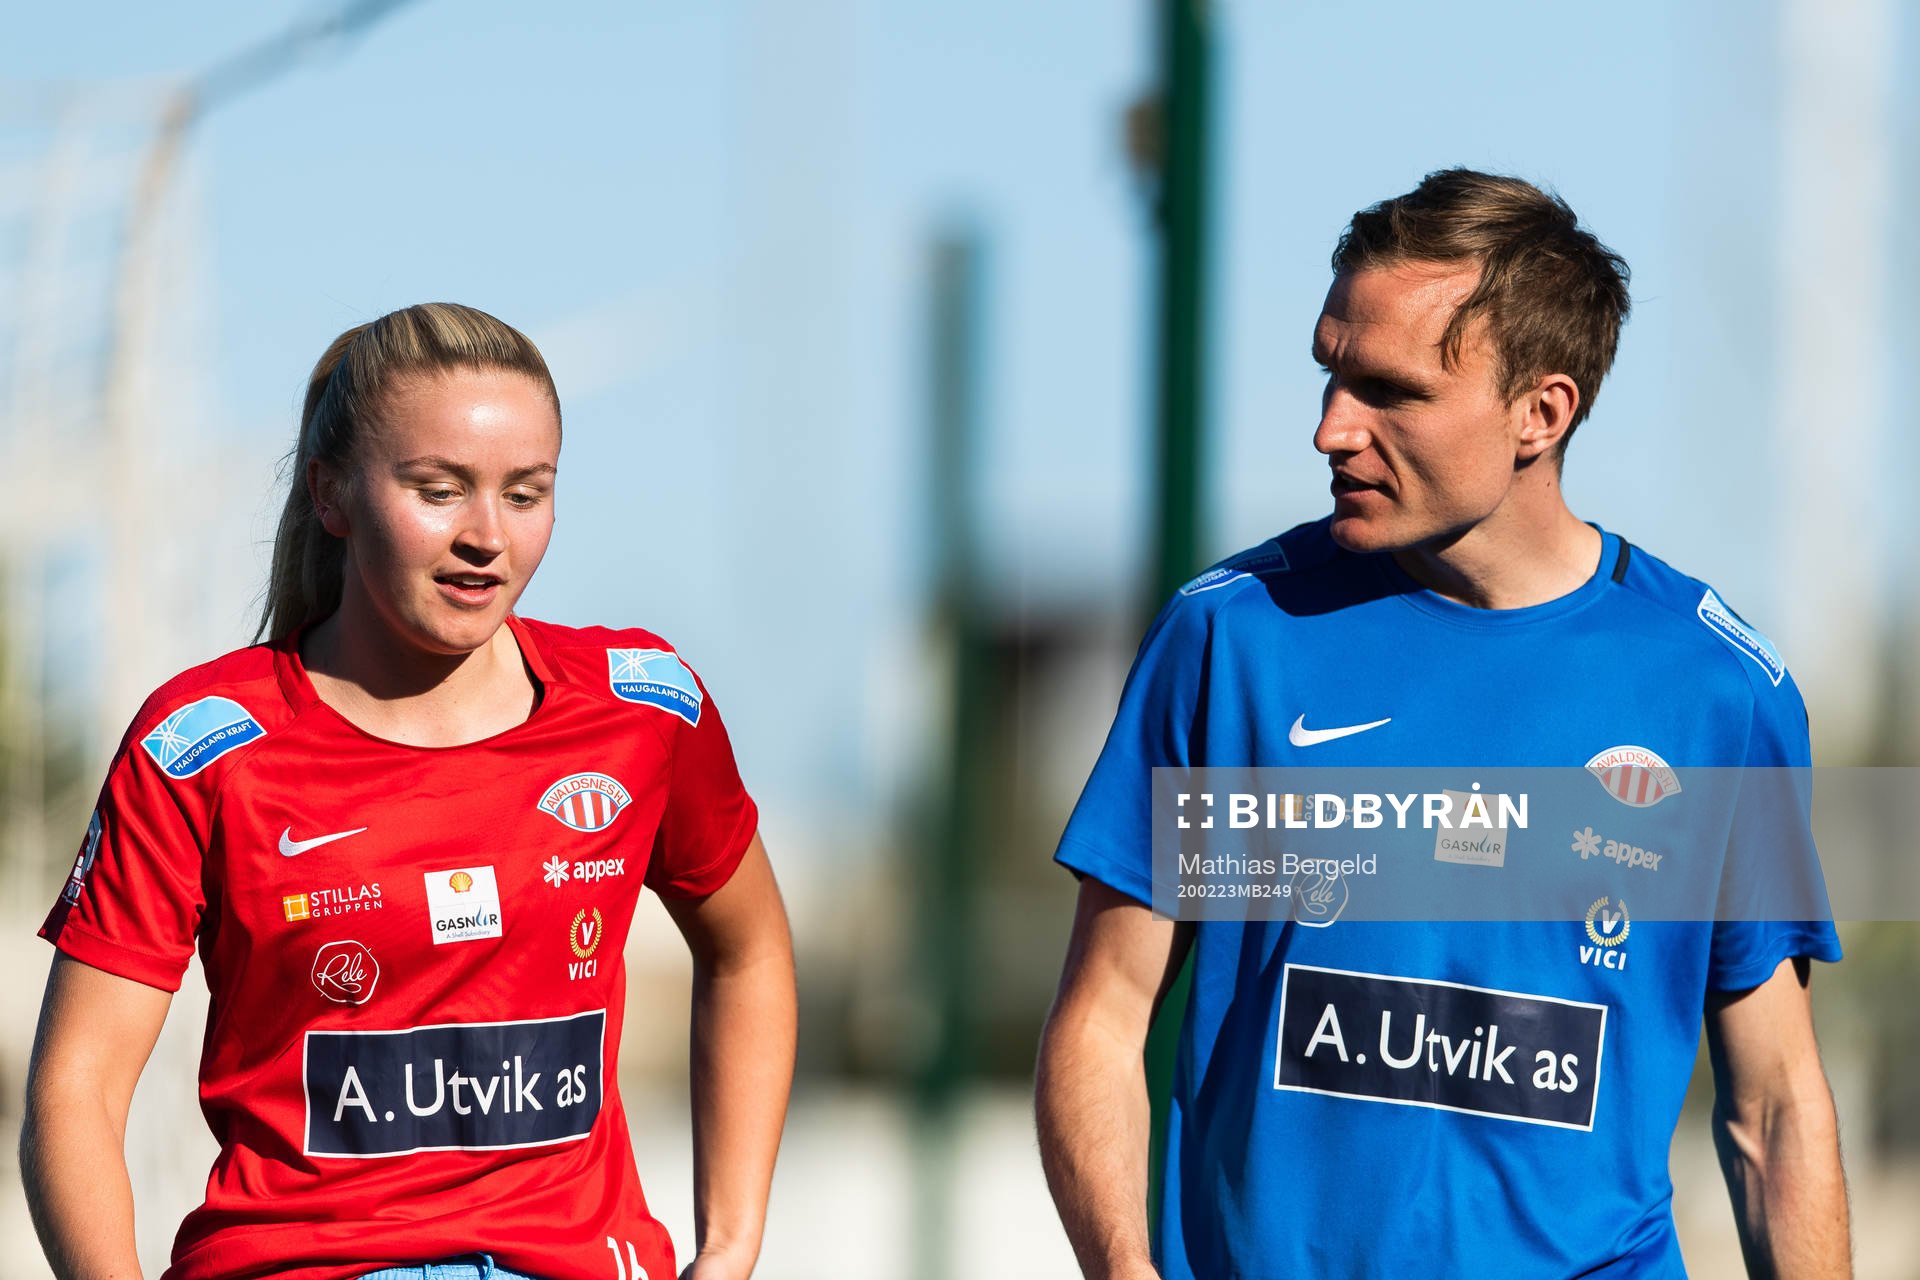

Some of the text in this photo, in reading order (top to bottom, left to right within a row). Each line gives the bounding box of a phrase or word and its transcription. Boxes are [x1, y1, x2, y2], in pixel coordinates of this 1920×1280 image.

[1706, 612, 1758, 650] HAUGALAND
[621, 684, 698, 711] HAUGALAND KRAFT
[174, 721, 252, 772] HAUGALAND KRAFT
[1596, 751, 1666, 779] AVALDSNES
[546, 777, 616, 810] AVALDSNES
[1603, 839, 1663, 872] appex
[573, 858, 625, 883] appex
[310, 882, 382, 907] STILLAS
[312, 899, 383, 918] GRUPPEN
[1602, 909, 1621, 934] V
[581, 921, 595, 946] V
[568, 959, 597, 981] VICI
[1579, 945, 1627, 971] VICI
[1303, 1003, 1579, 1093] A. Utvik as
[333, 1055, 587, 1122] A. Utvik as
